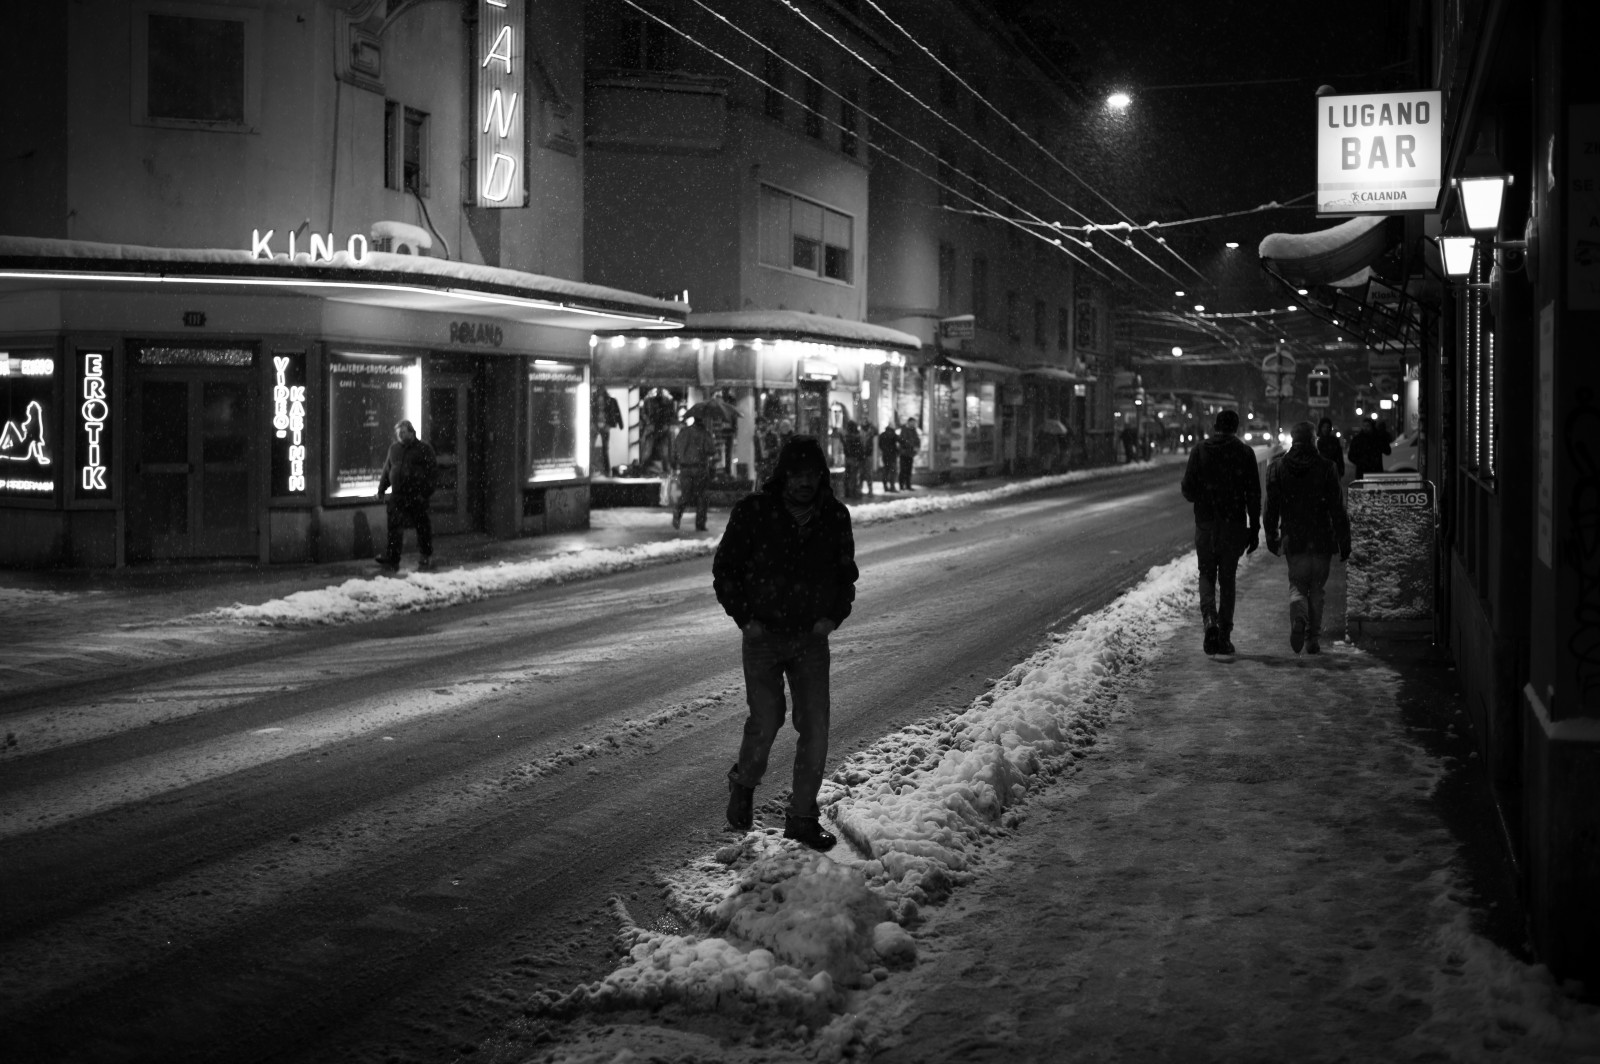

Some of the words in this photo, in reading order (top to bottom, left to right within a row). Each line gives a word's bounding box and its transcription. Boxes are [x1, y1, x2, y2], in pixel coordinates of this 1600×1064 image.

[482, 0, 517, 202] AND
[1328, 101, 1431, 128] LUGANO
[1341, 134, 1416, 171] BAR
[1583, 142, 1600, 154] ZI
[1360, 190, 1407, 201] CALANDA
[251, 228, 369, 264] KINO
[450, 321, 503, 347] ROLAND
[82, 353, 108, 490] EROTIK
[289, 385, 305, 491] KABINEN
